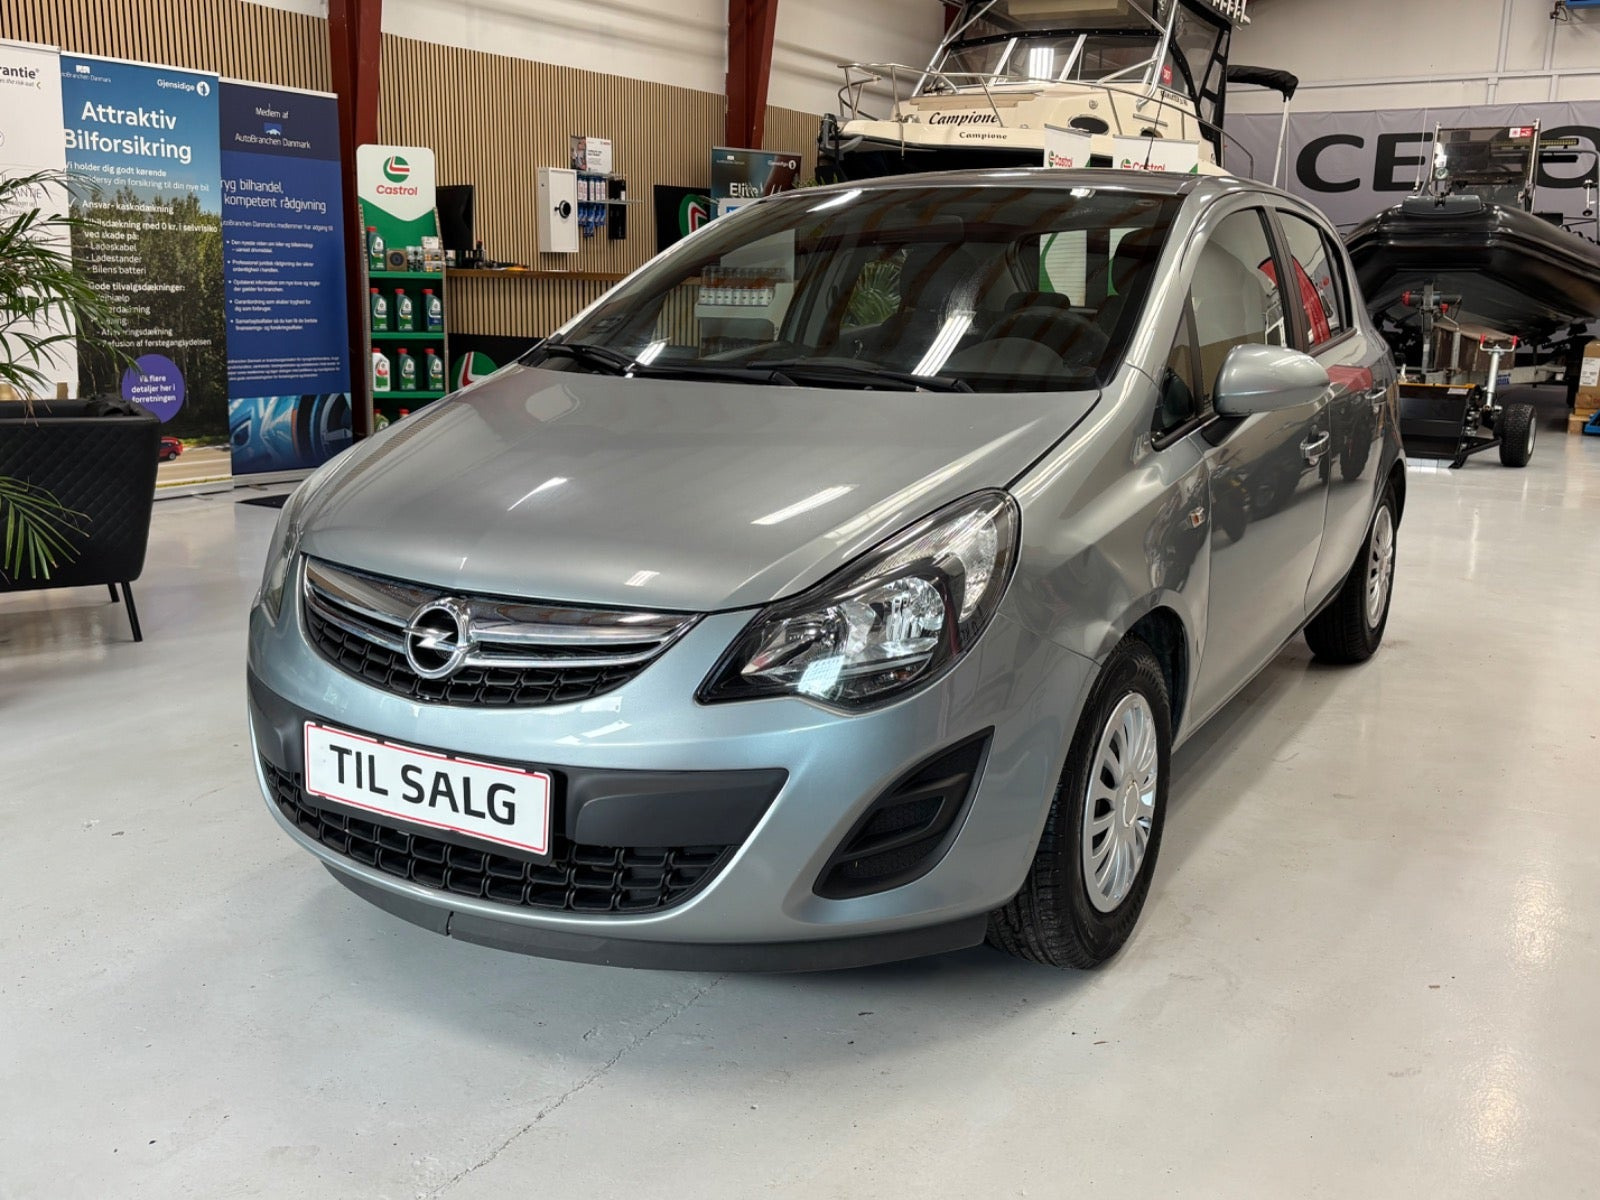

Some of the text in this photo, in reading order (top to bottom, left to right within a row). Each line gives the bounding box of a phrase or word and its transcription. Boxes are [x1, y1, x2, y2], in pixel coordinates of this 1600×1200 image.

[157, 78, 195, 92] Gjensidige
[81, 101, 177, 130] Attraktiv
[928, 110, 999, 127] Campione
[234, 132, 312, 150] AutoBranchen Danmark
[959, 131, 1008, 140] Campione
[64, 128, 192, 164] Bilforsikring
[1055, 154, 1073, 168] Castrol
[74, 161, 101, 172] holder
[102, 163, 115, 175] dig
[116, 165, 135, 176] godt
[136, 166, 167, 177] kørende
[128, 178, 162, 190] forsikring
[219, 178, 285, 195] ryg bilhandel,
[376, 184, 418, 196] Castrol
[223, 192, 327, 215] kompetent rådgivning
[142, 221, 161, 230] med
[102, 231, 125, 240] skade
[119, 265, 147, 275] batteri
[131, 384, 159, 395] detaljer
[329, 744, 516, 826] TIL SALG
